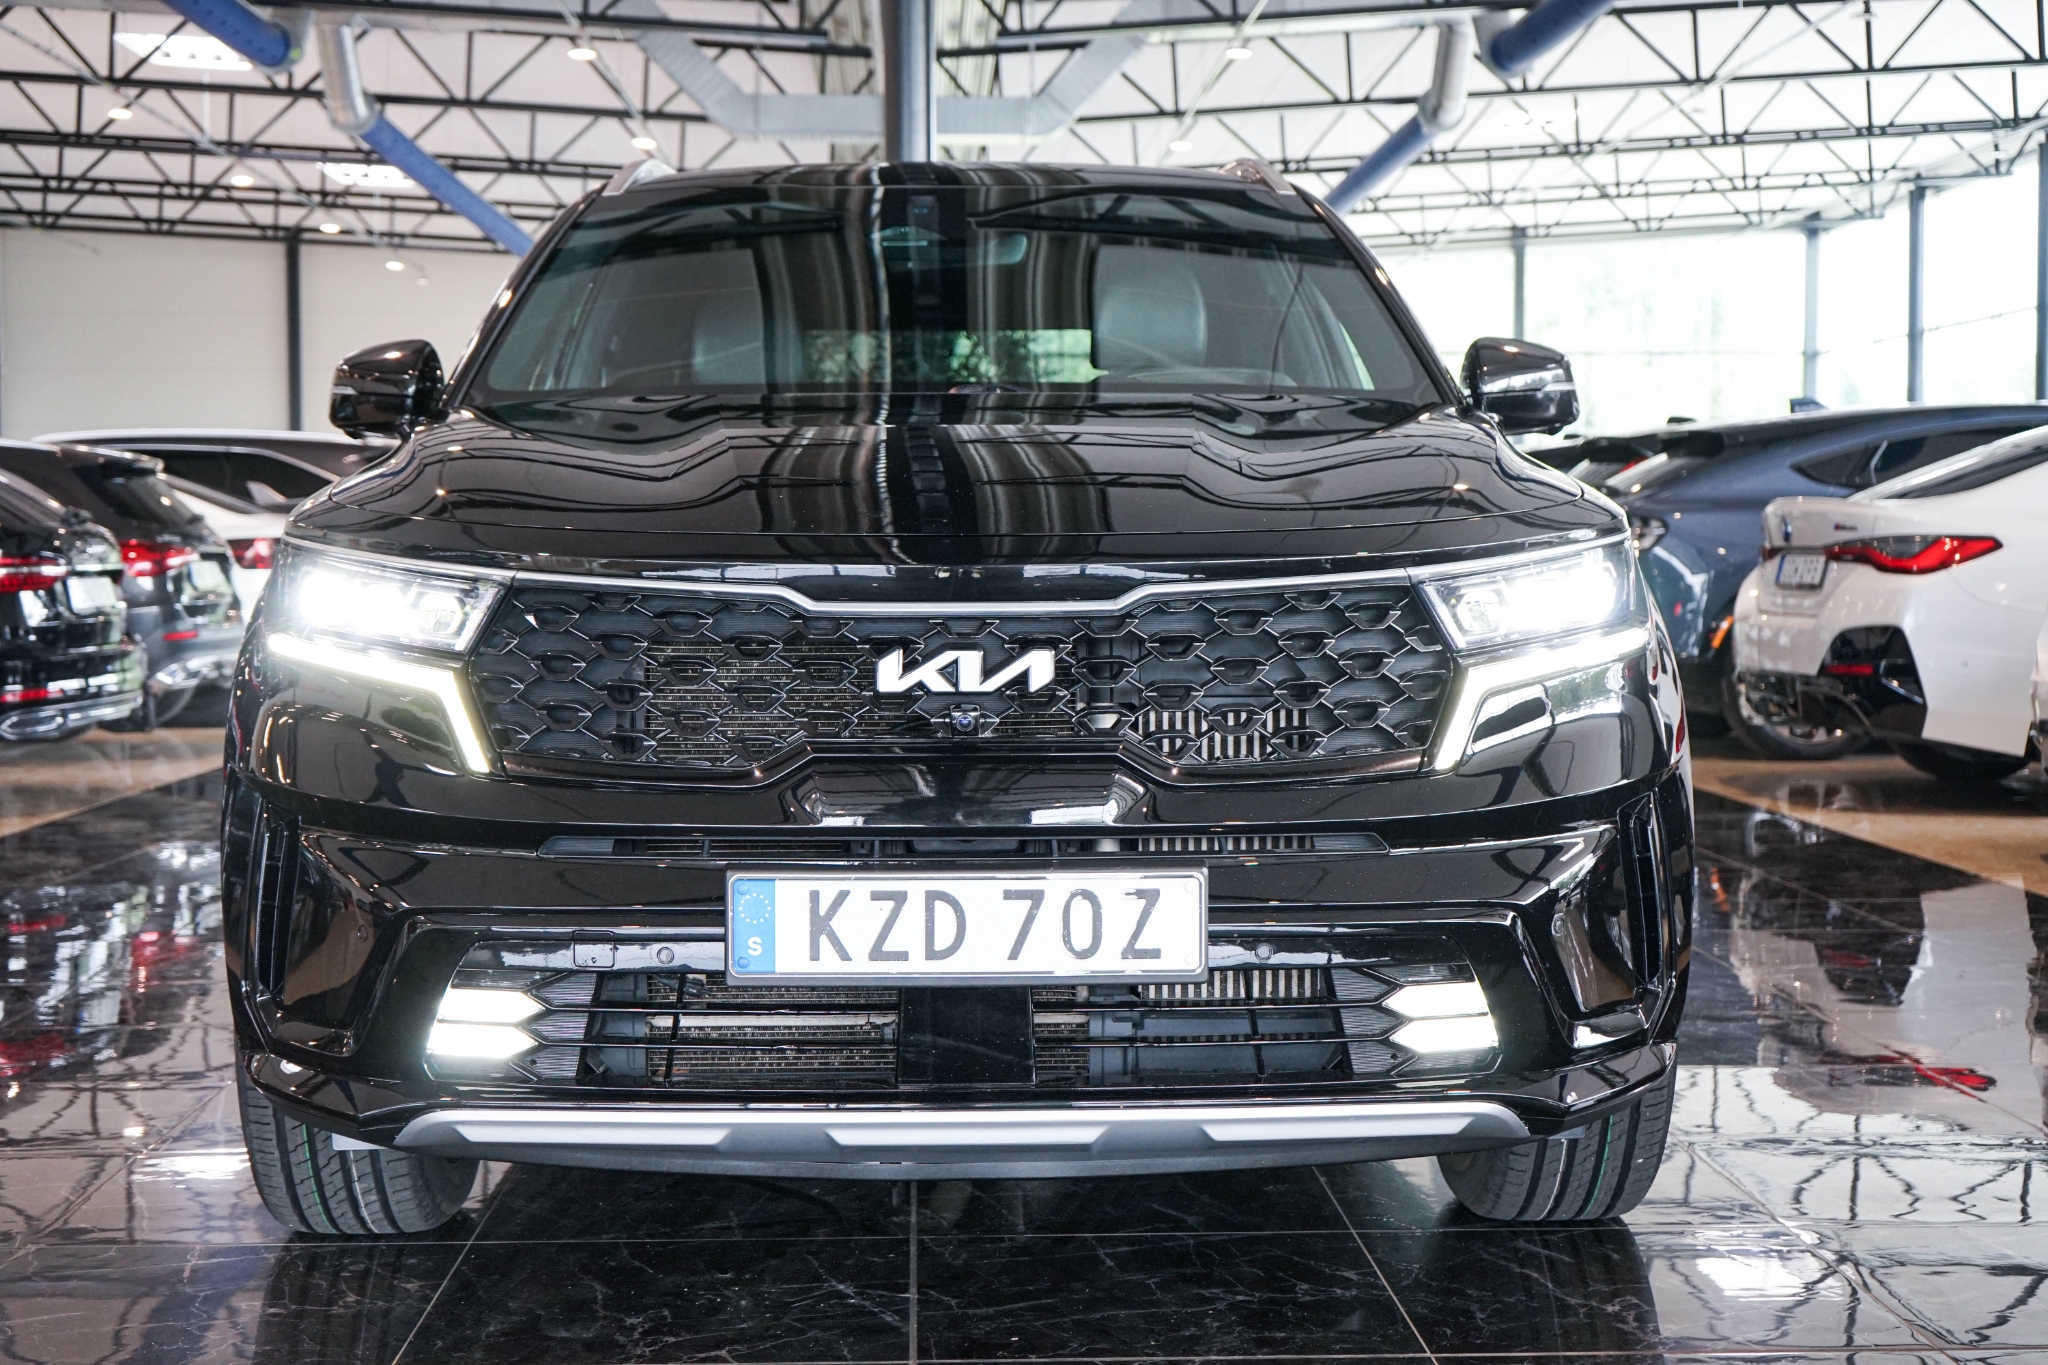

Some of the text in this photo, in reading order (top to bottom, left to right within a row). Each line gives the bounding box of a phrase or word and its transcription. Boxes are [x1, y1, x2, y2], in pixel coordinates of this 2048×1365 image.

[876, 646, 1055, 696] KIA
[747, 936, 762, 956] S
[808, 888, 1162, 962] KZD 70Z
